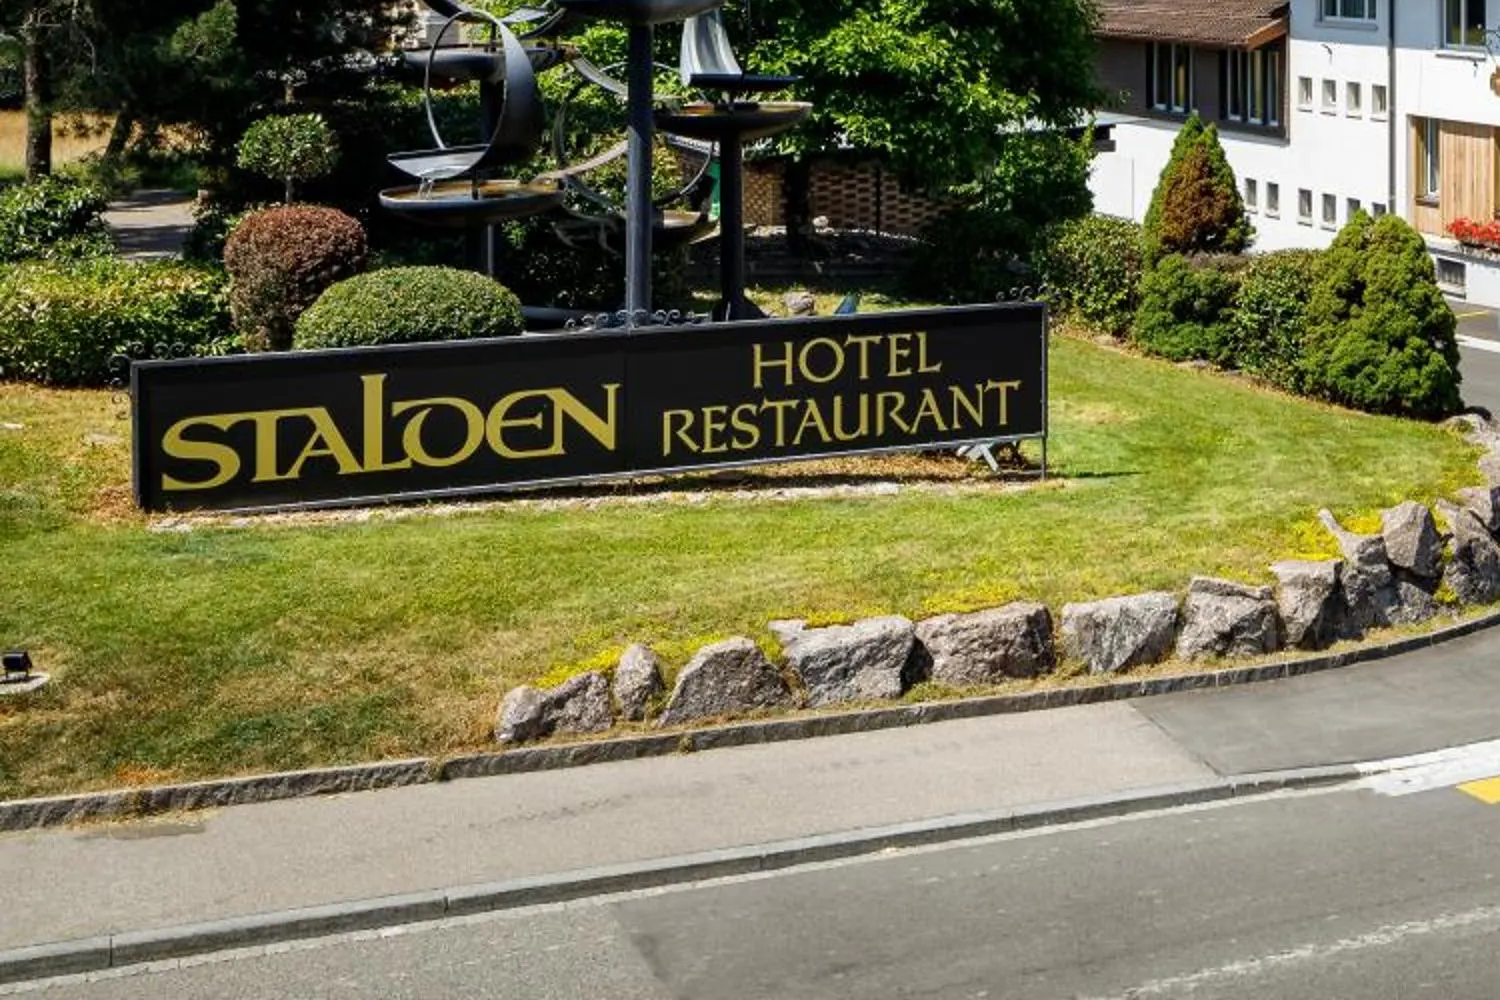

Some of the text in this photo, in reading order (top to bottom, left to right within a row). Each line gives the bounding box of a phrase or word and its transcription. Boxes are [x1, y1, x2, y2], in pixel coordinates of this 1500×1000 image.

[752, 332, 942, 387] HOTEL
[161, 373, 620, 490] STALDEN
[663, 380, 1021, 455] RESTAURANT
